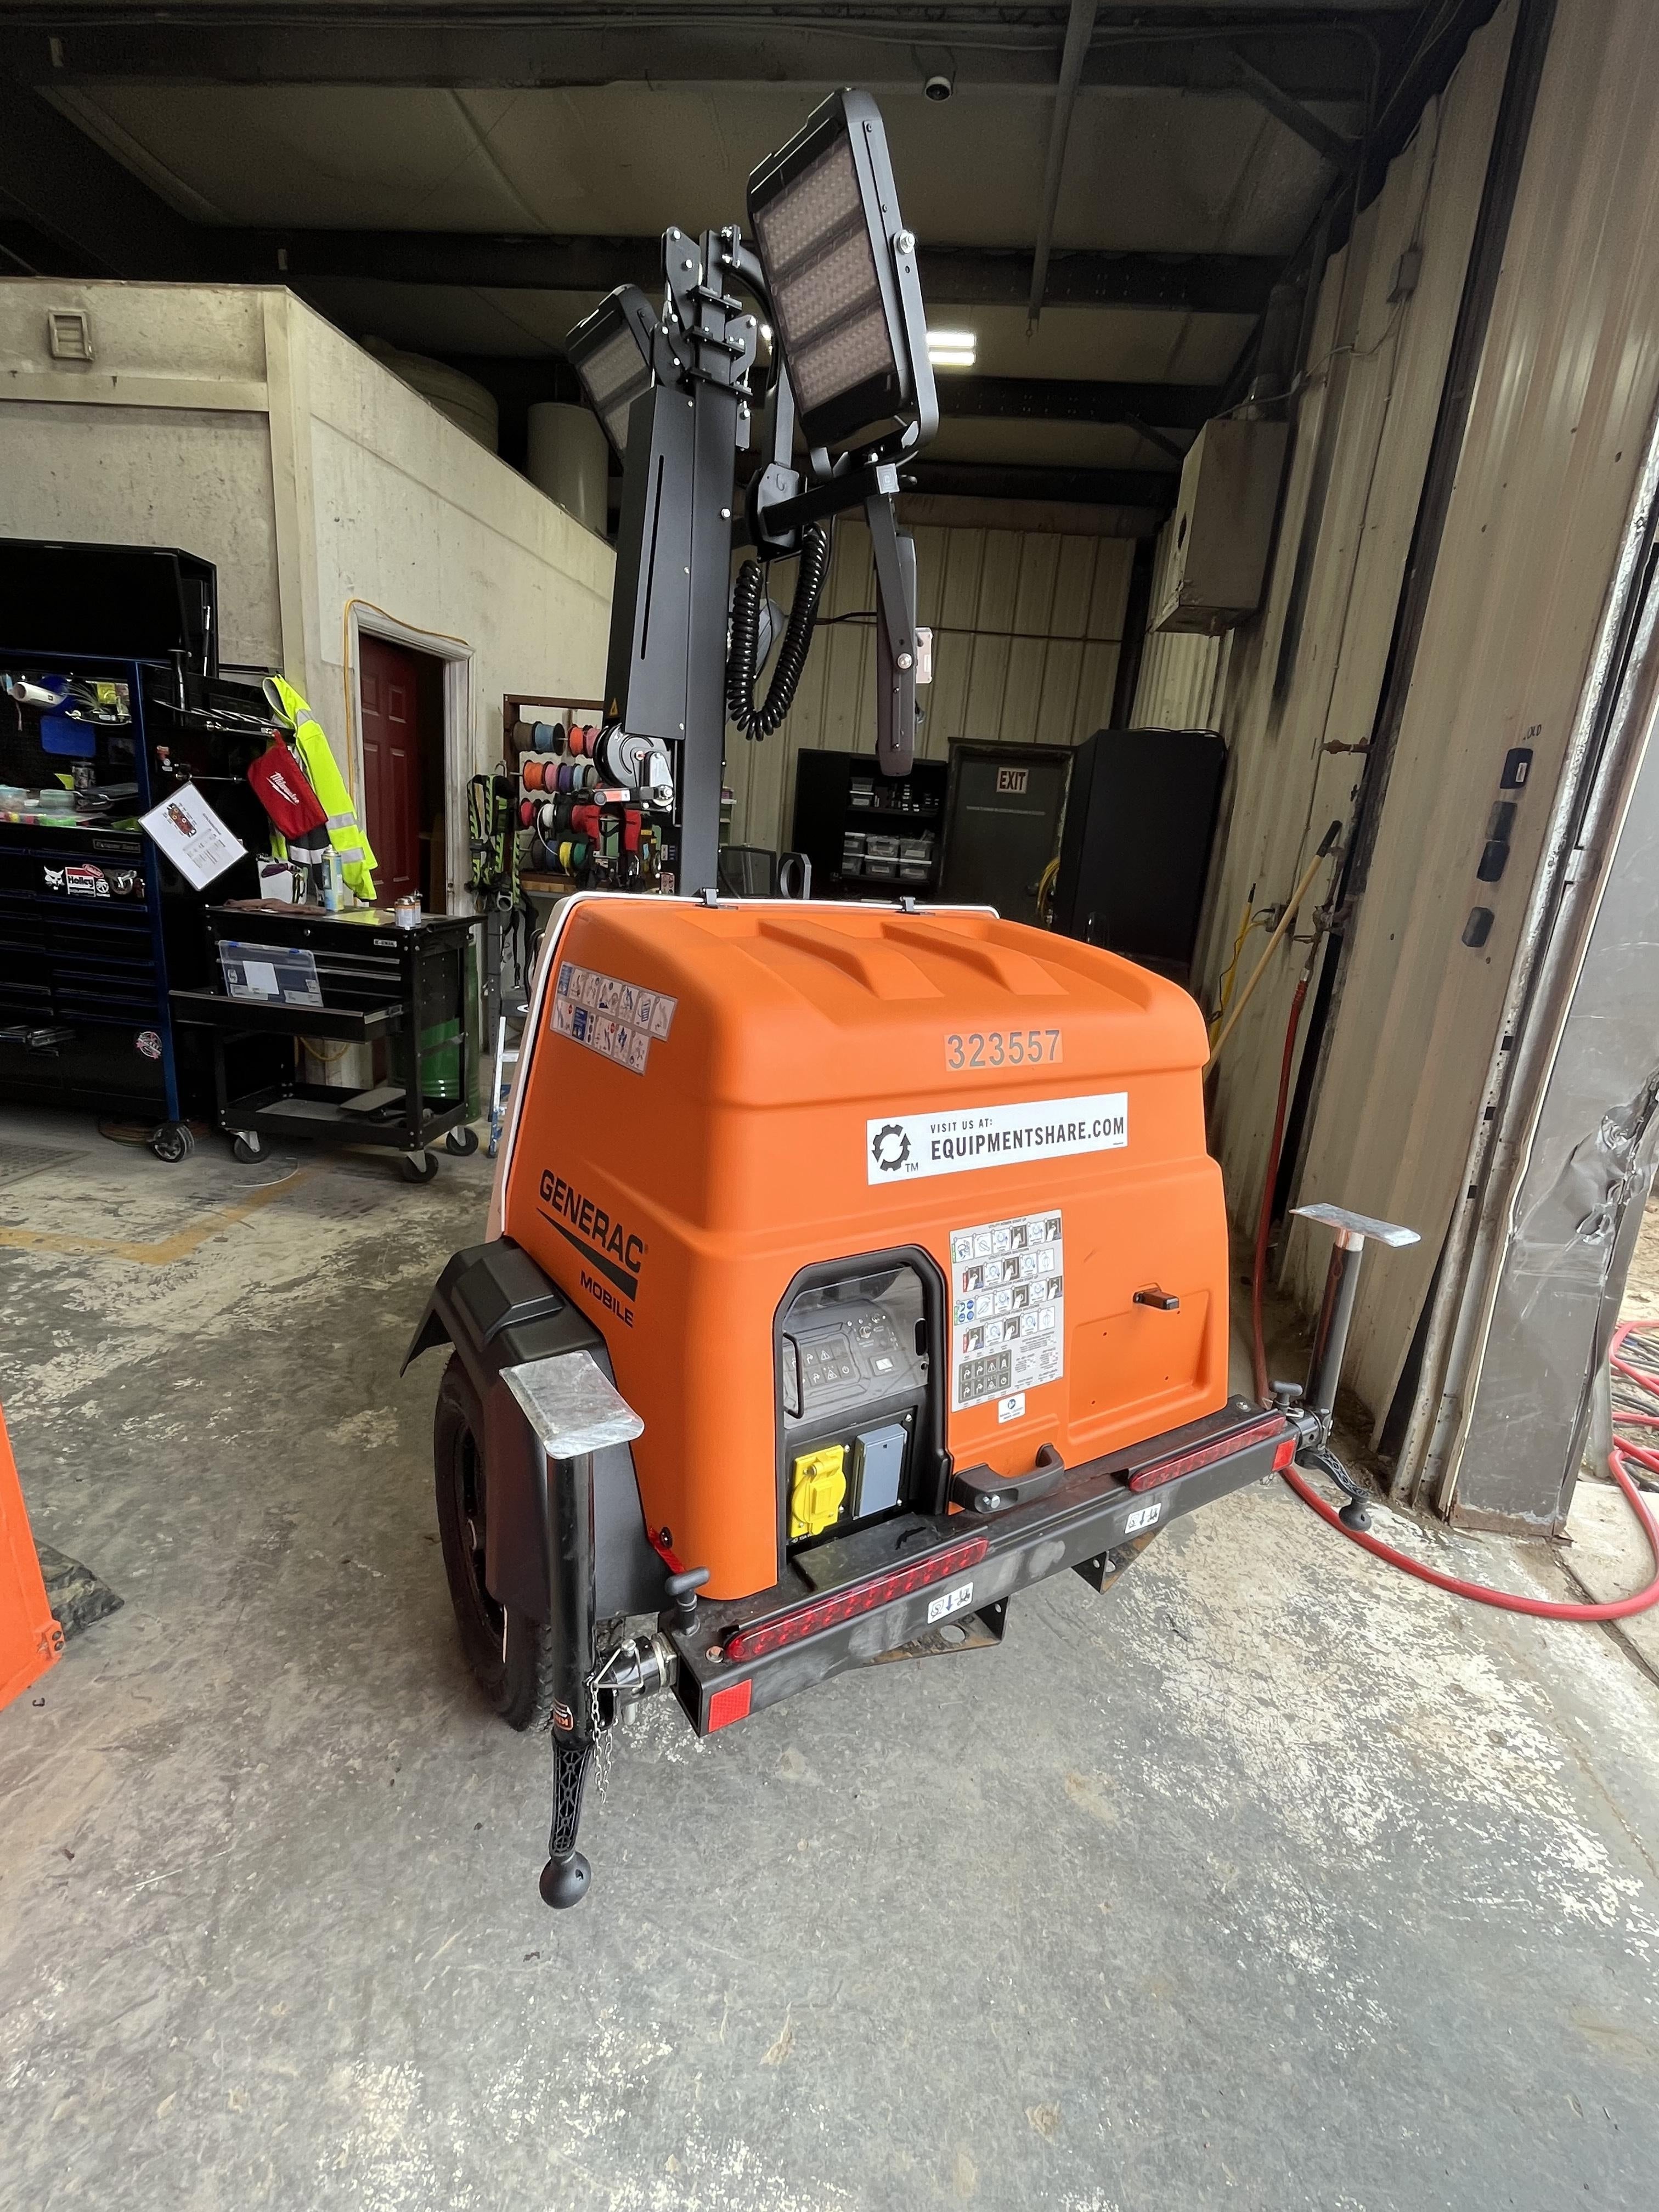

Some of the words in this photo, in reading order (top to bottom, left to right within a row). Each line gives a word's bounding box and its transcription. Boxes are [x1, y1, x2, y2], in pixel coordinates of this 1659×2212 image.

[1000, 771, 1026, 791] EXIT
[67, 876, 93, 888] Holley
[947, 1029, 1060, 1069] 323557
[930, 1121, 957, 1134] VISIT
[962, 1120, 974, 1130] US
[978, 1118, 993, 1128] AT:
[932, 1116, 1124, 1160] EQUIPMENTSHARE.COM
[905, 1162, 919, 1172] TM
[540, 1169, 643, 1273] GENERAC
[580, 1270, 634, 1328] MOBILE
